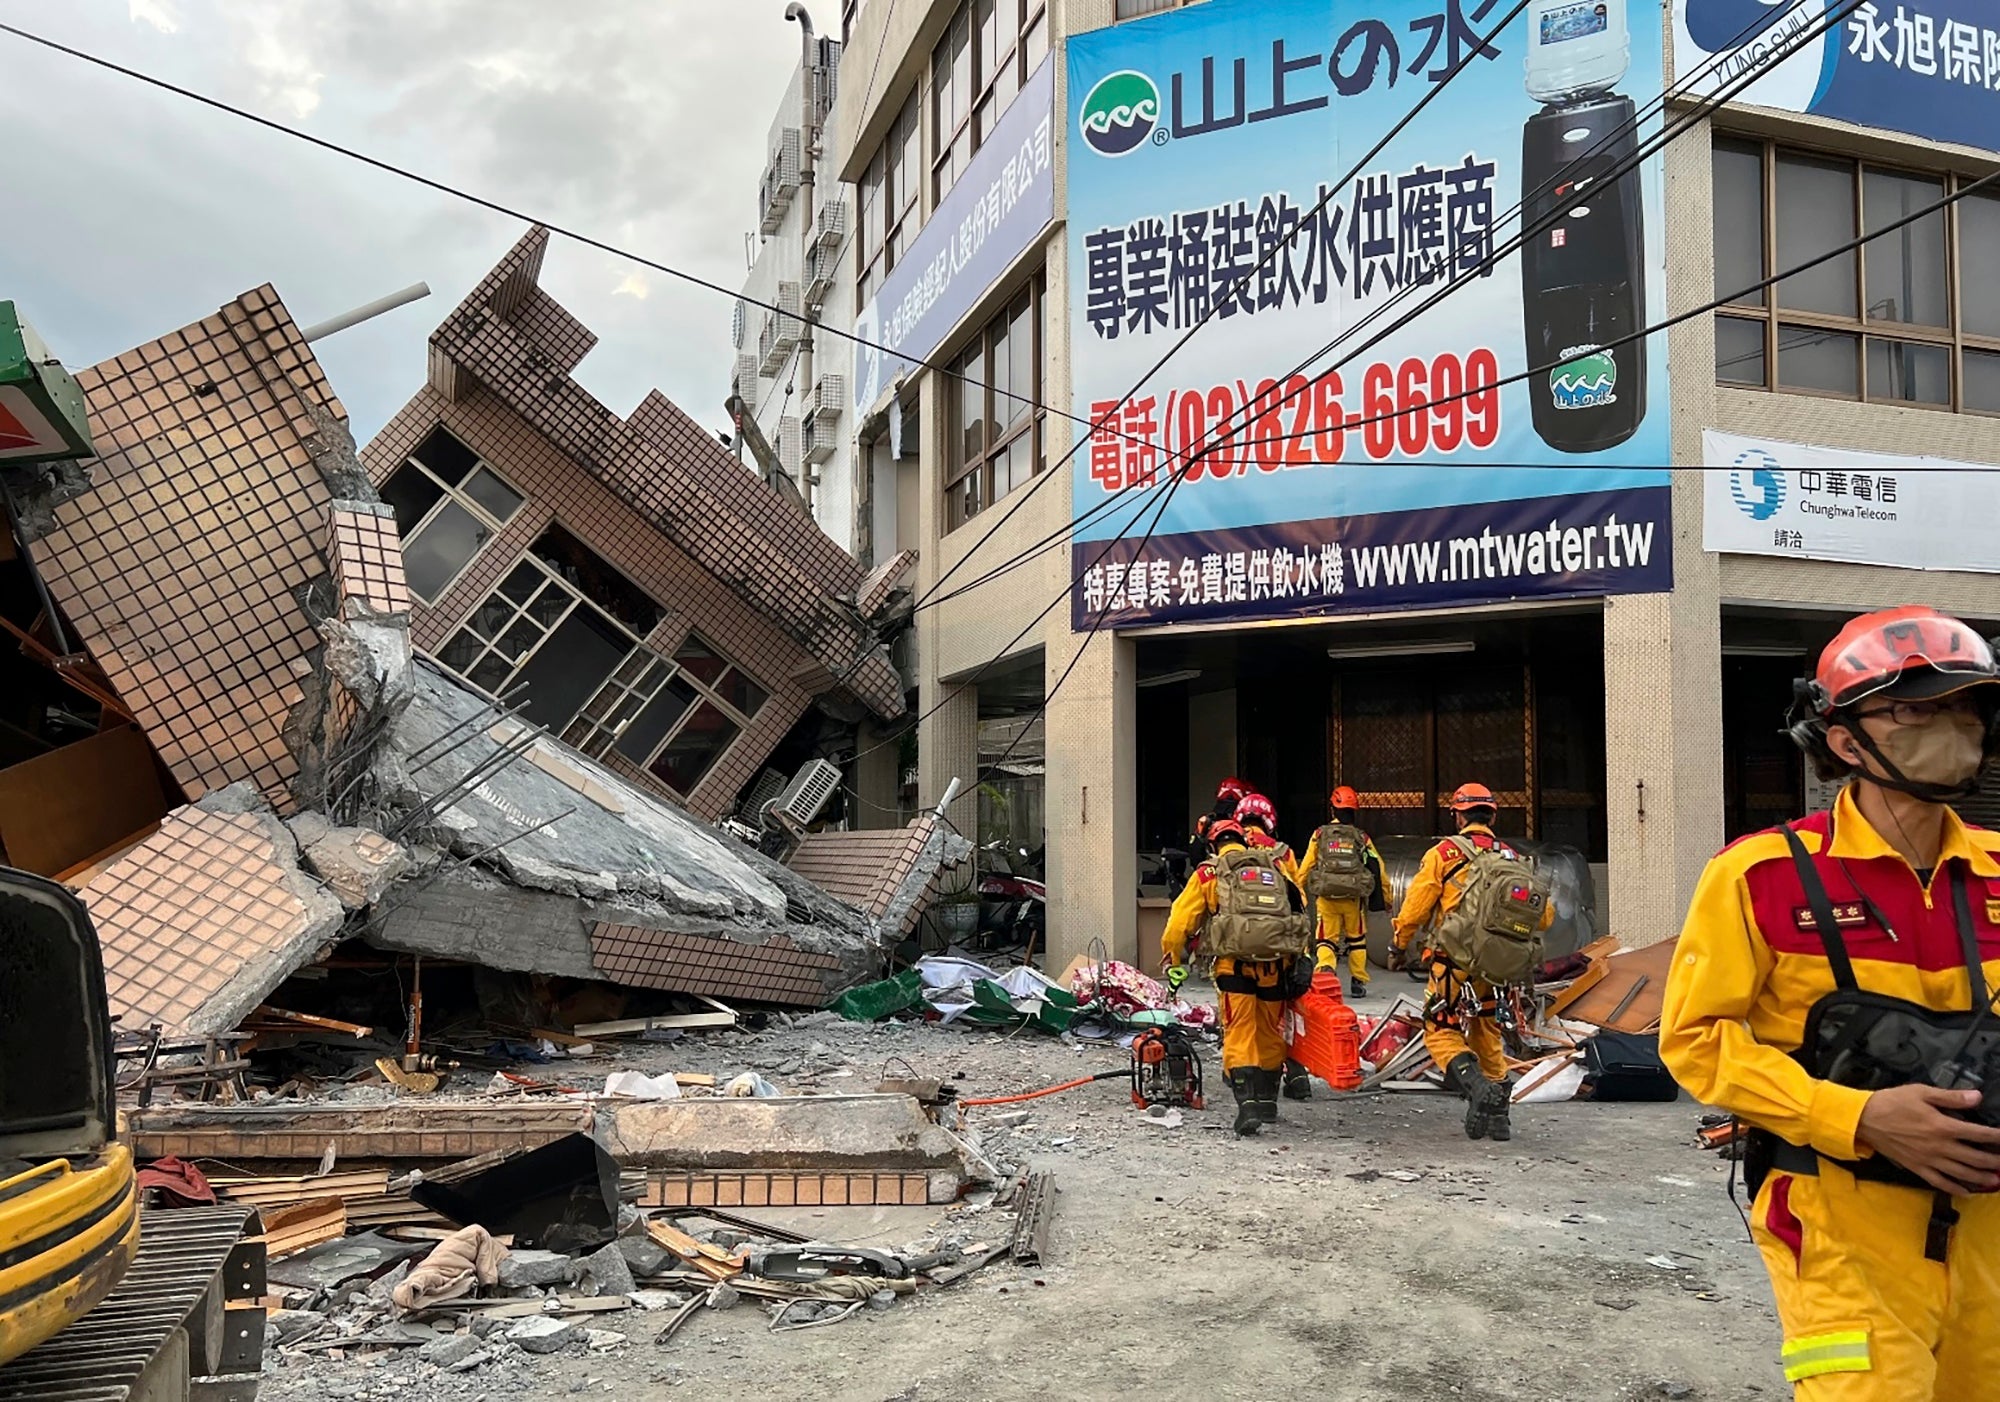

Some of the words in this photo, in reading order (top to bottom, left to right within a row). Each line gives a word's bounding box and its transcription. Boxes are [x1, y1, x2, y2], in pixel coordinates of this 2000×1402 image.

[1172, 0, 1503, 139] 山上の水
[1086, 154, 1496, 339] 專業桶裝飲水供應商
[1800, 470, 1897, 503] 中華電信
[1800, 500, 1855, 520] Chunghwa
[1855, 505, 1897, 521] Telecom
[1351, 513, 1654, 588] www.mtwater.tw
[1774, 528, 1803, 549] 請洽
